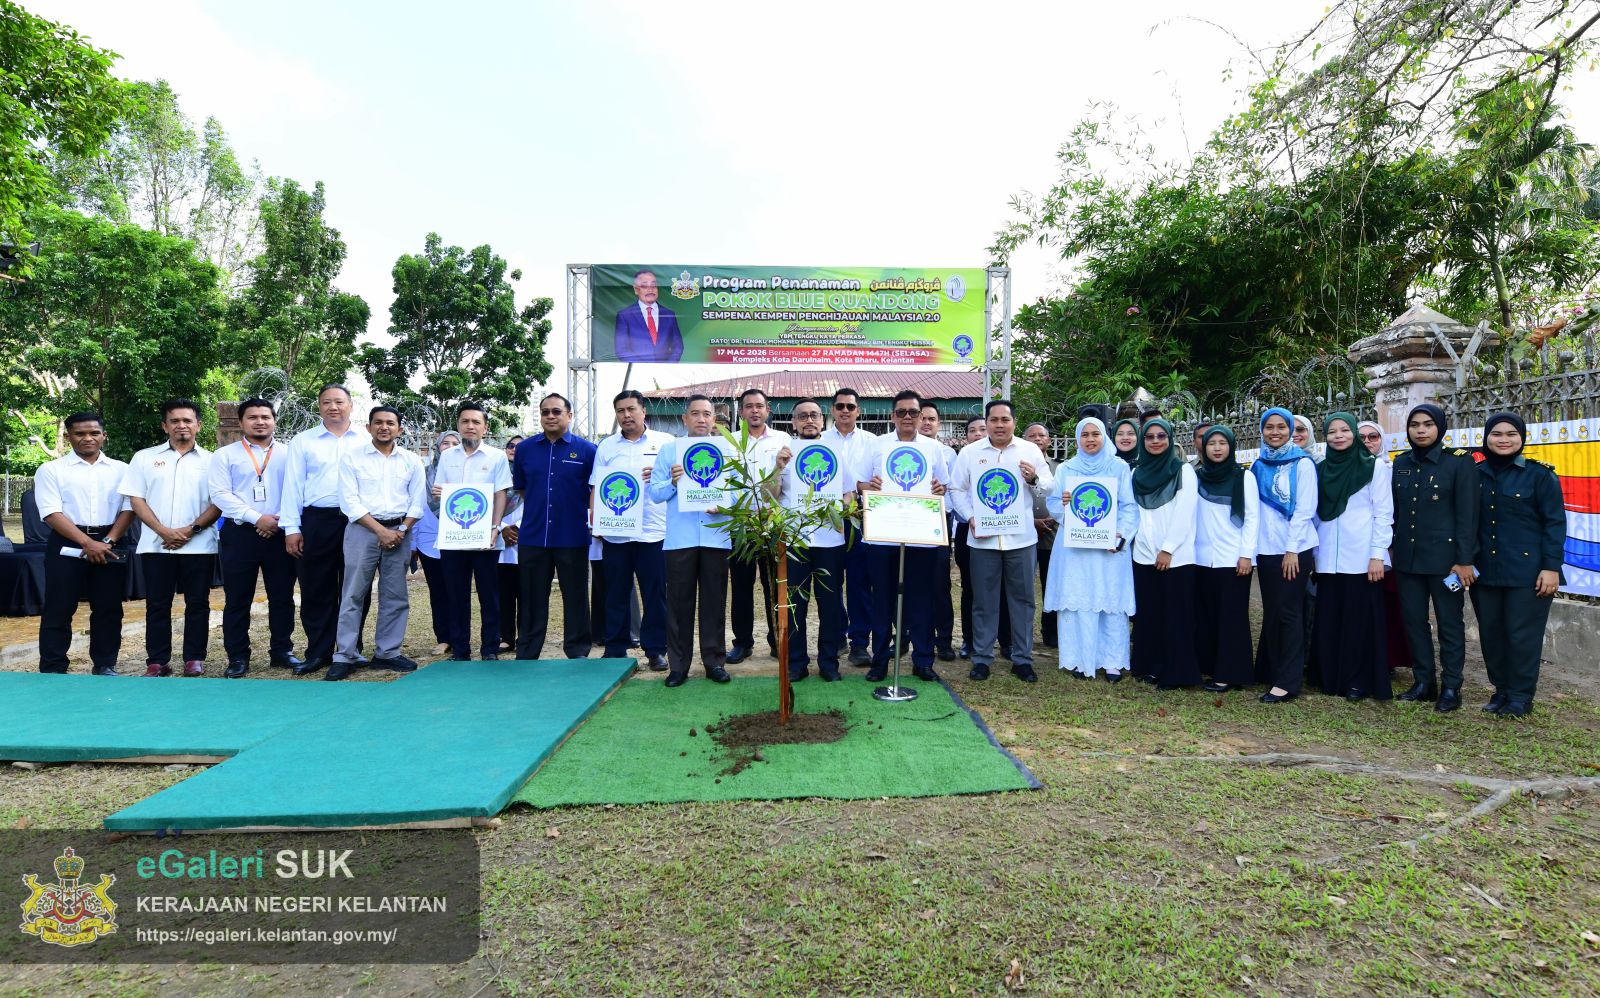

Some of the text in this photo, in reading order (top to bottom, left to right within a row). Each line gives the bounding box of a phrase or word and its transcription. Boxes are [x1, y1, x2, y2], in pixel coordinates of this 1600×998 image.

[702, 275, 860, 292] Program Penanaman
[702, 291, 940, 312] POKOK BLUE QUANDONG
[702, 311, 941, 322] SEMPENA KEMPEN PENGHIJAUAN MALAYSIA 2.0
[732, 356, 771, 364] Kompleks
[1070, 532, 1109, 540] MALAYSIA
